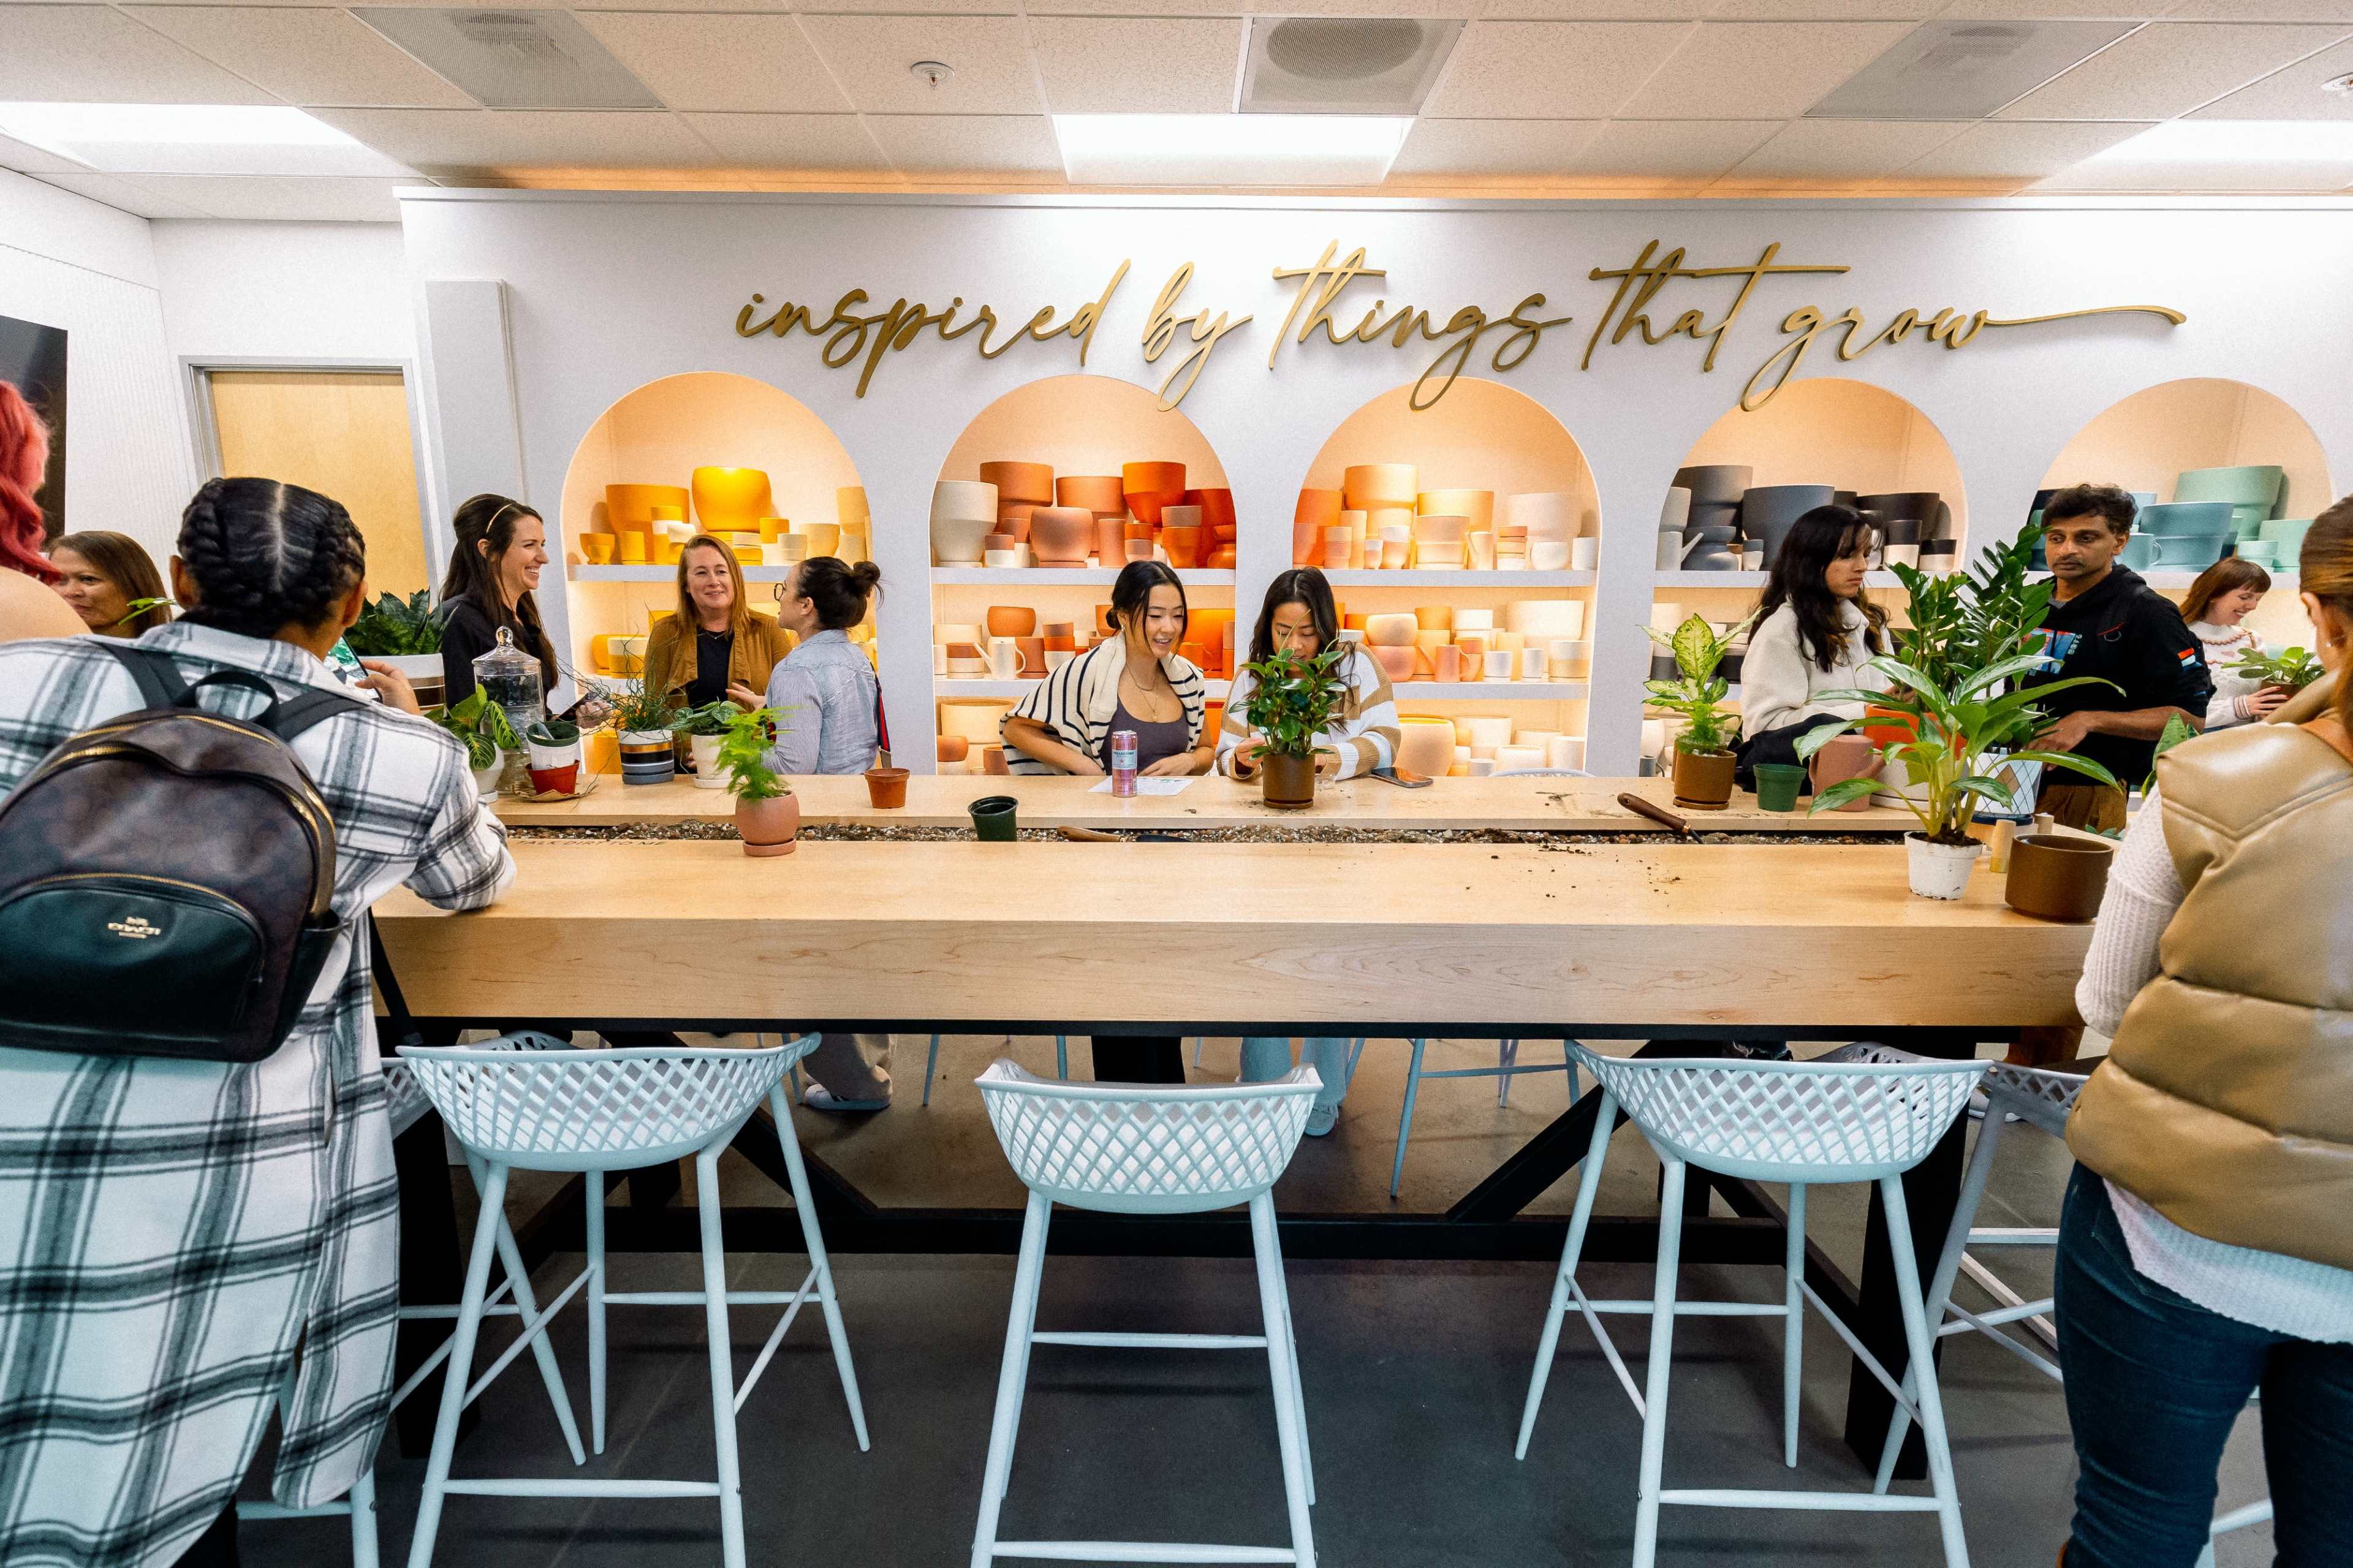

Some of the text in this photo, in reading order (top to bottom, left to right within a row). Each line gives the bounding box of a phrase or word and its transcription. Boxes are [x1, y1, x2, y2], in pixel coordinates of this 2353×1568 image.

[735, 239, 2188, 412] inspired by things that grow
